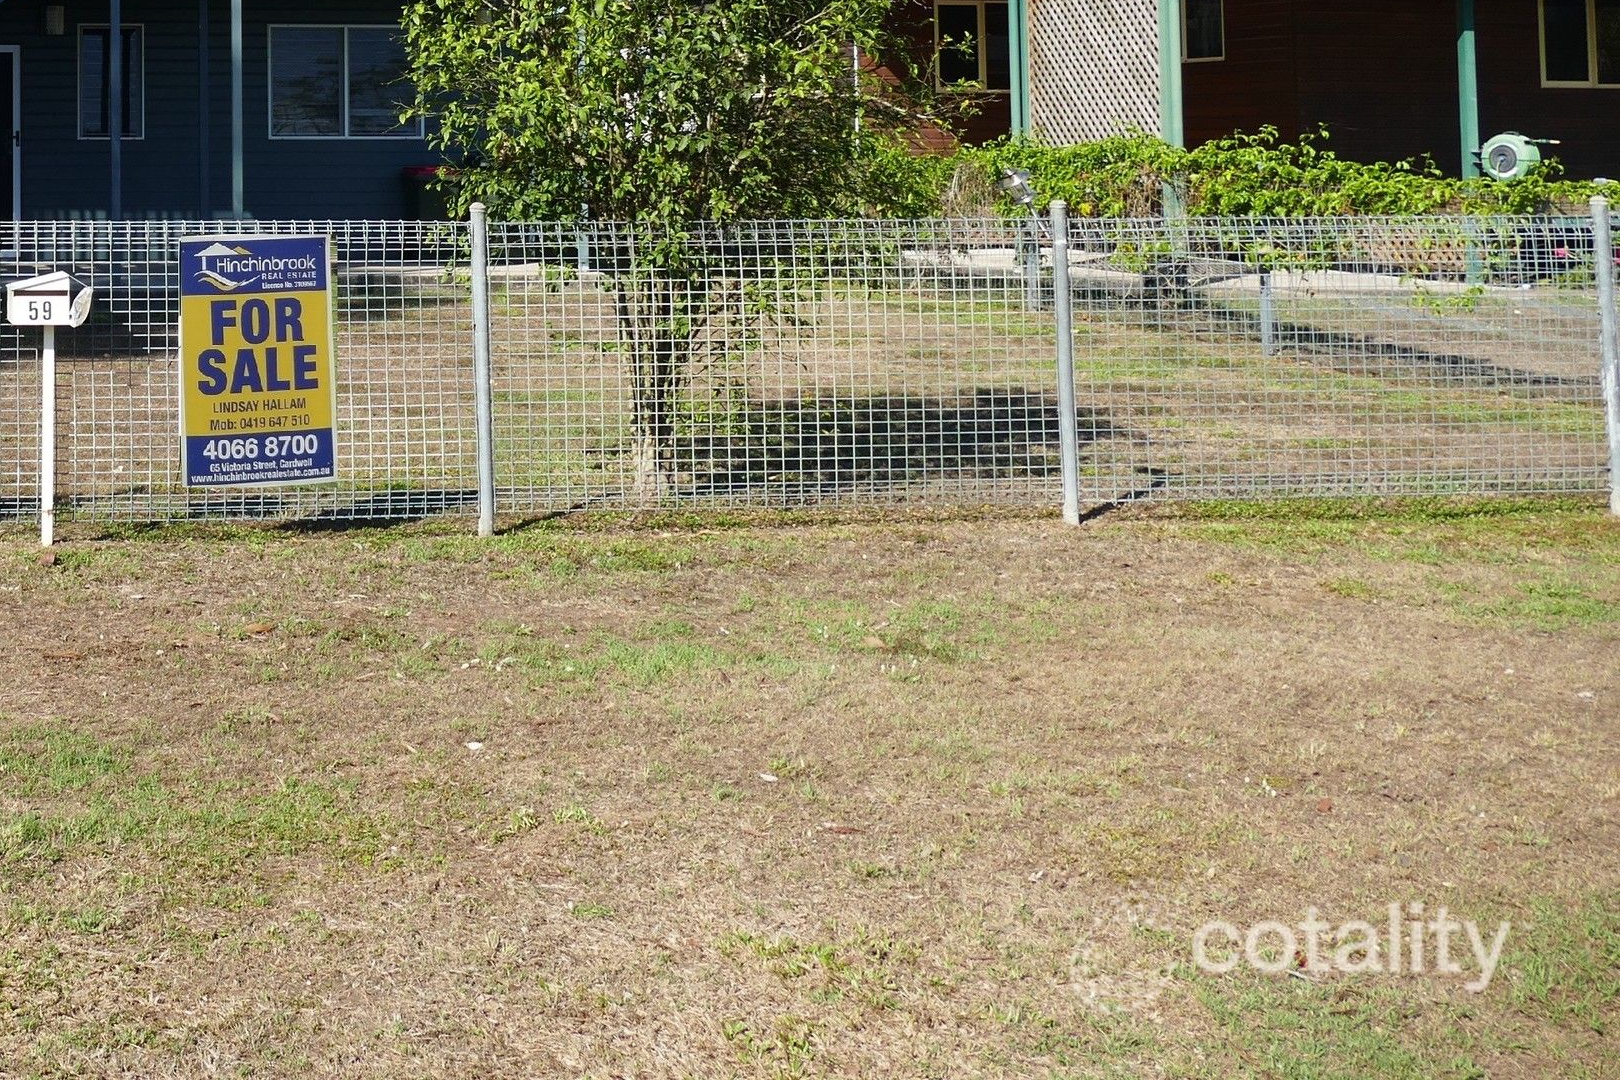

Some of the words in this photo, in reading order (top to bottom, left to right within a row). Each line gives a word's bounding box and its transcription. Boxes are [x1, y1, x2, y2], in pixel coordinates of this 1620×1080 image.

[216, 254, 316, 273] Hinchinbrook
[261, 272, 284, 280] REAL
[286, 271, 317, 279] ESTATE
[28, 300, 52, 321] 59
[210, 297, 304, 346] FOR
[197, 344, 319, 396] SALE
[213, 401, 259, 413] LINDSAY
[262, 398, 306, 411] HALLAM
[210, 419, 237, 431] Mob:
[239, 417, 266, 430] 0419
[268, 416, 288, 427] 647
[291, 414, 310, 426] 510
[202, 438, 259, 460] 4066
[264, 434, 318, 457] 8700
[209, 463, 221, 472] 65
[221, 461, 252, 472] Victoria
[252, 460, 279, 470] Street,
[279, 457, 313, 469] Cardwell
[191, 467, 331, 483] www.hinchinbrookrealestate.com.au
